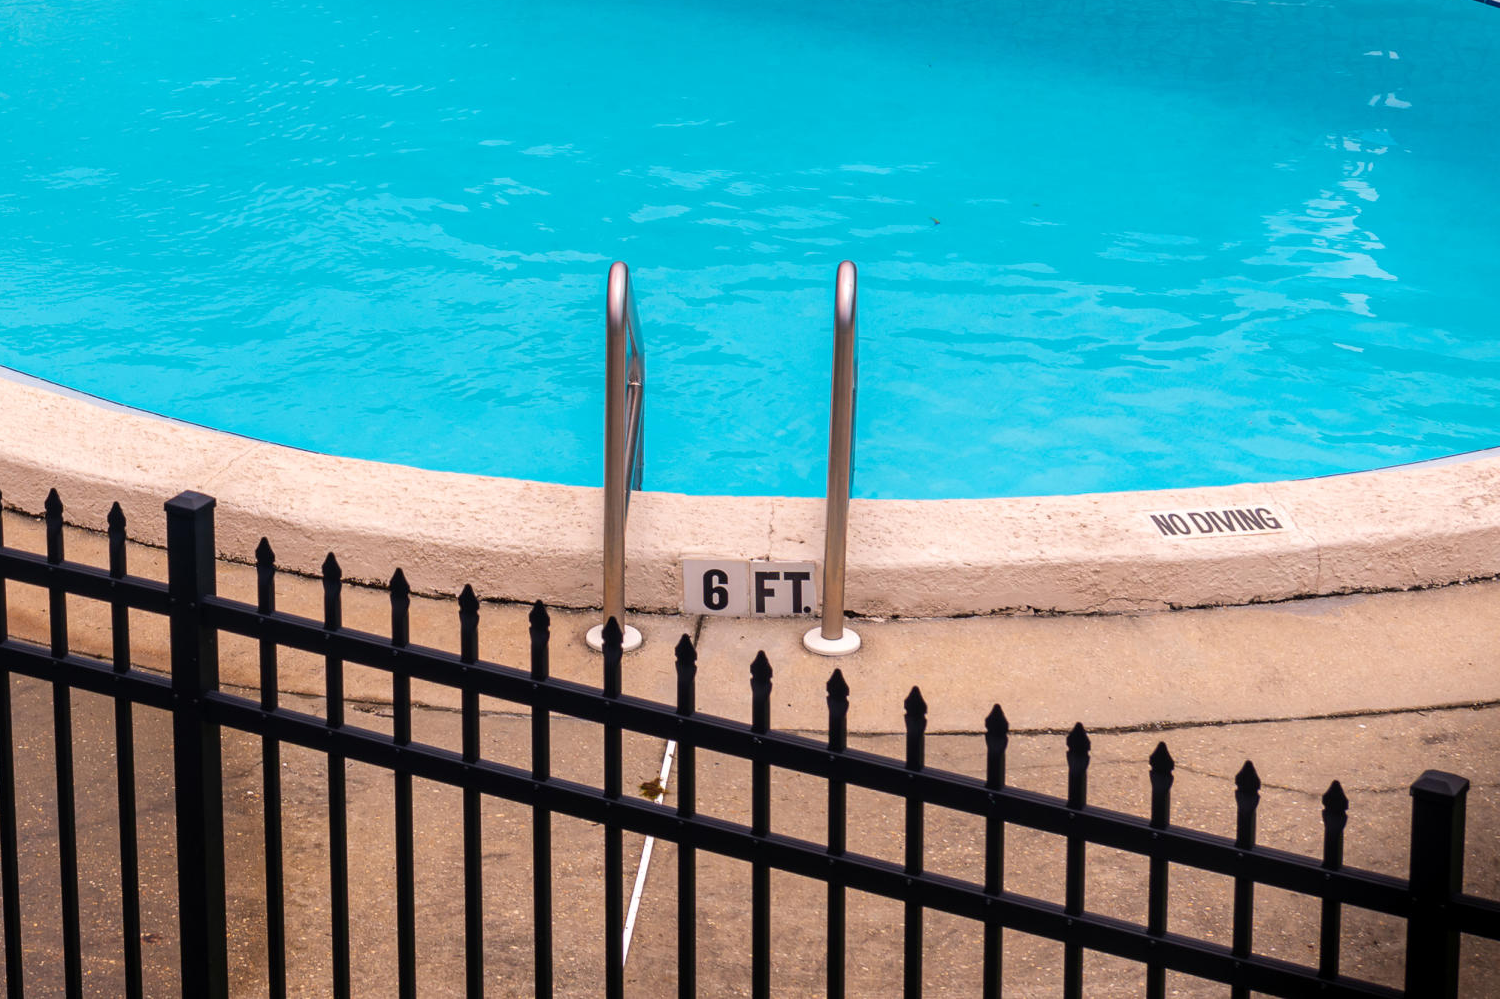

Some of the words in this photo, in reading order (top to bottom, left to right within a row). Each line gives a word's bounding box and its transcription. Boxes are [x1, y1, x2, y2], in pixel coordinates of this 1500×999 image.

[1149, 512, 1192, 536] NO
[1187, 507, 1284, 534] DIVING
[702, 568, 729, 611] 6
[754, 571, 812, 614] FT.
